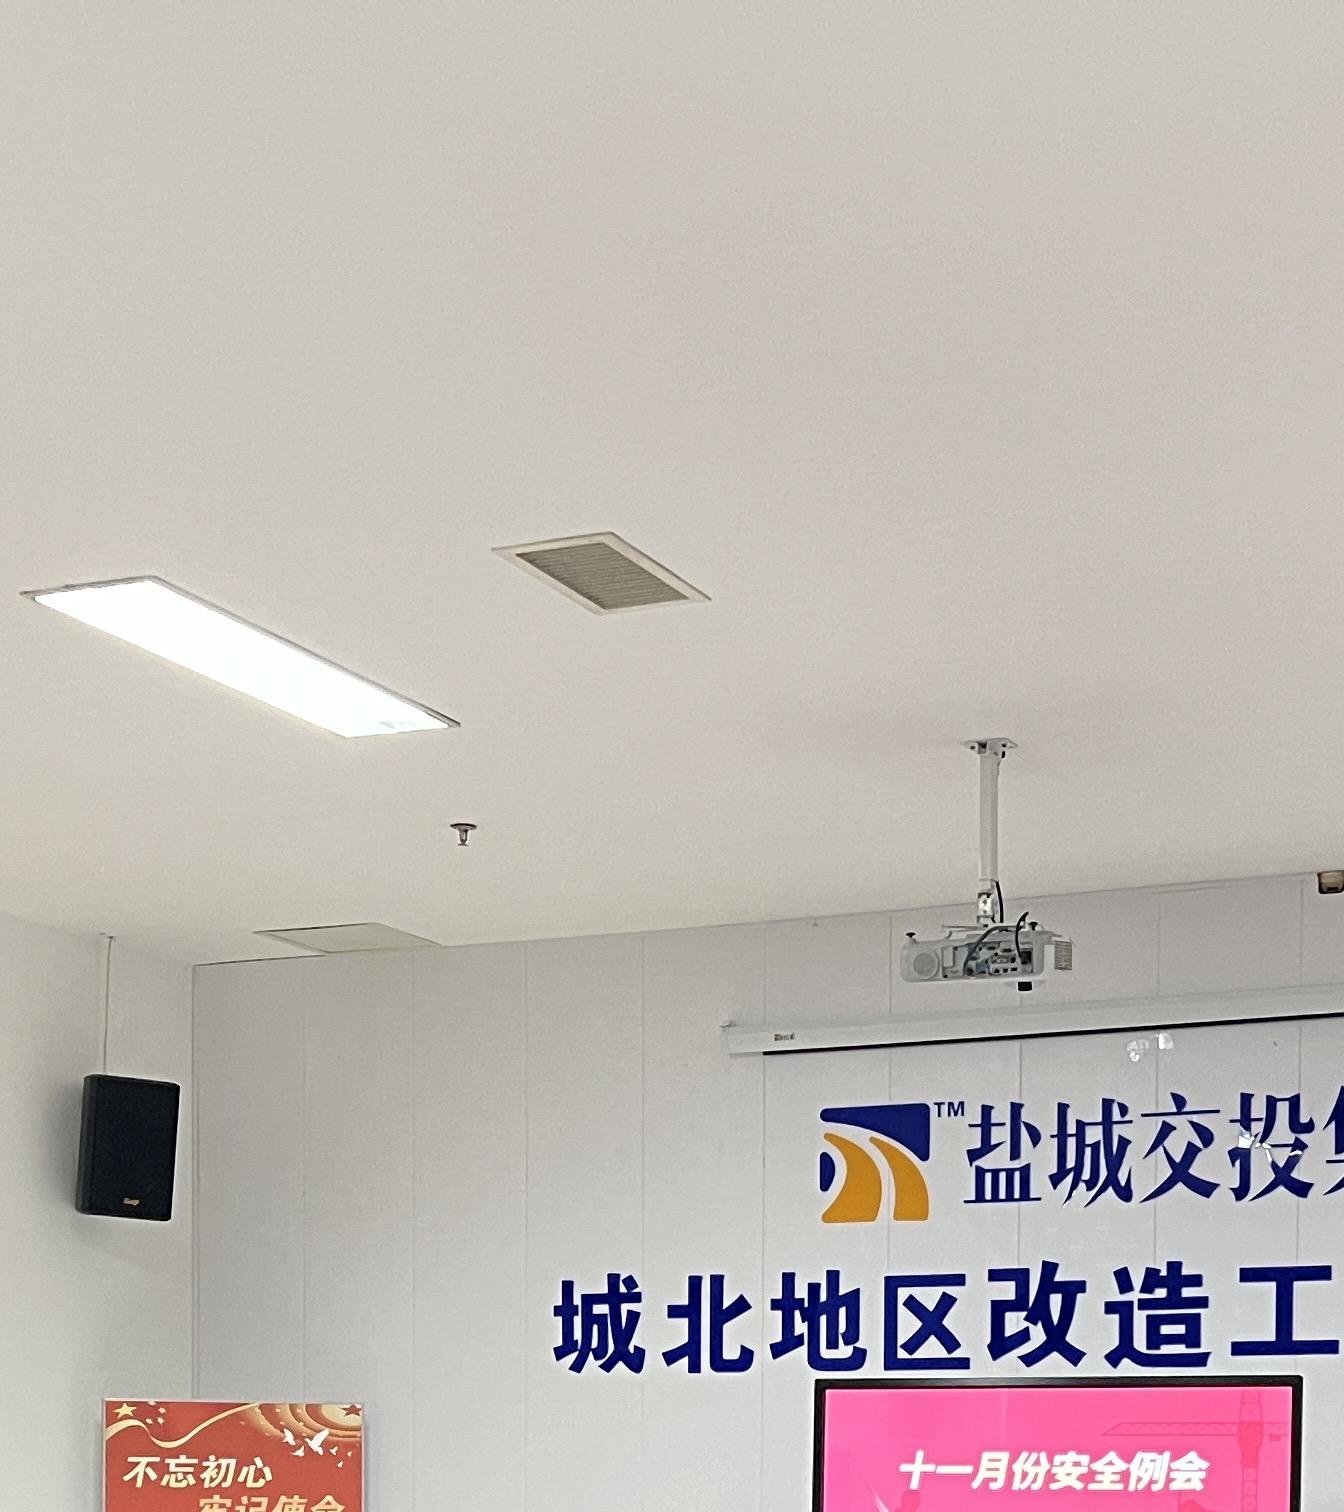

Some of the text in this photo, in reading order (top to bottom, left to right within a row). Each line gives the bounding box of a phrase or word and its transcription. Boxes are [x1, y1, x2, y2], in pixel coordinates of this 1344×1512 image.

[123, 1454, 273, 1489] 不忘初心
[899, 1448, 1211, 1493] 十一月份安全例会
